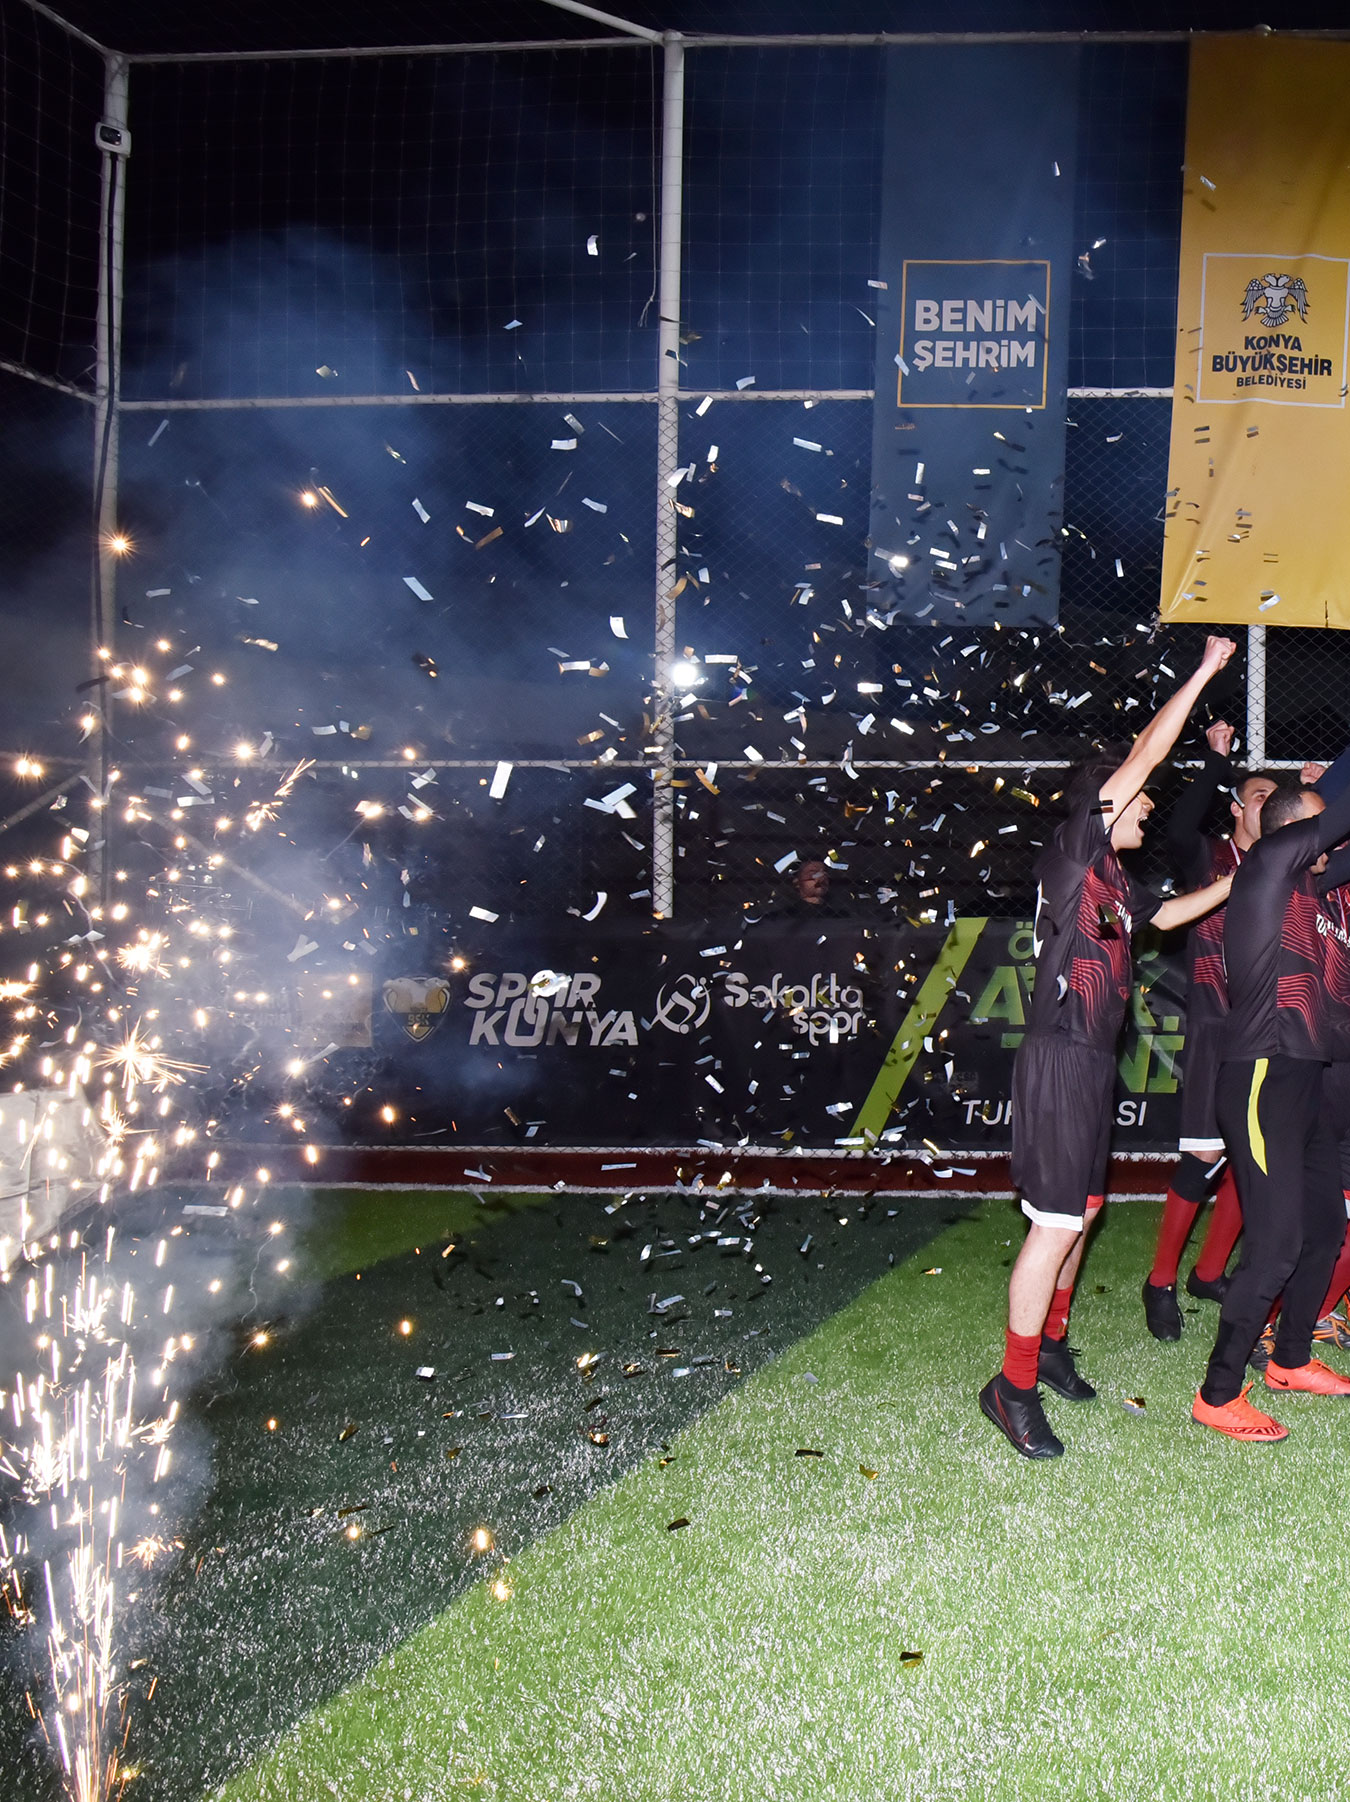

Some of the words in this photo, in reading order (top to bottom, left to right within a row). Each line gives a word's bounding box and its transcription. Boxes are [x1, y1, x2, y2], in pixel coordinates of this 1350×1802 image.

[1243, 332, 1303, 353] KONYA
[1211, 350, 1333, 377] BÜYÜKŞEHİR
[1236, 373, 1307, 390] BELEDİYESİ
[468, 1003, 640, 1047] KONYA
